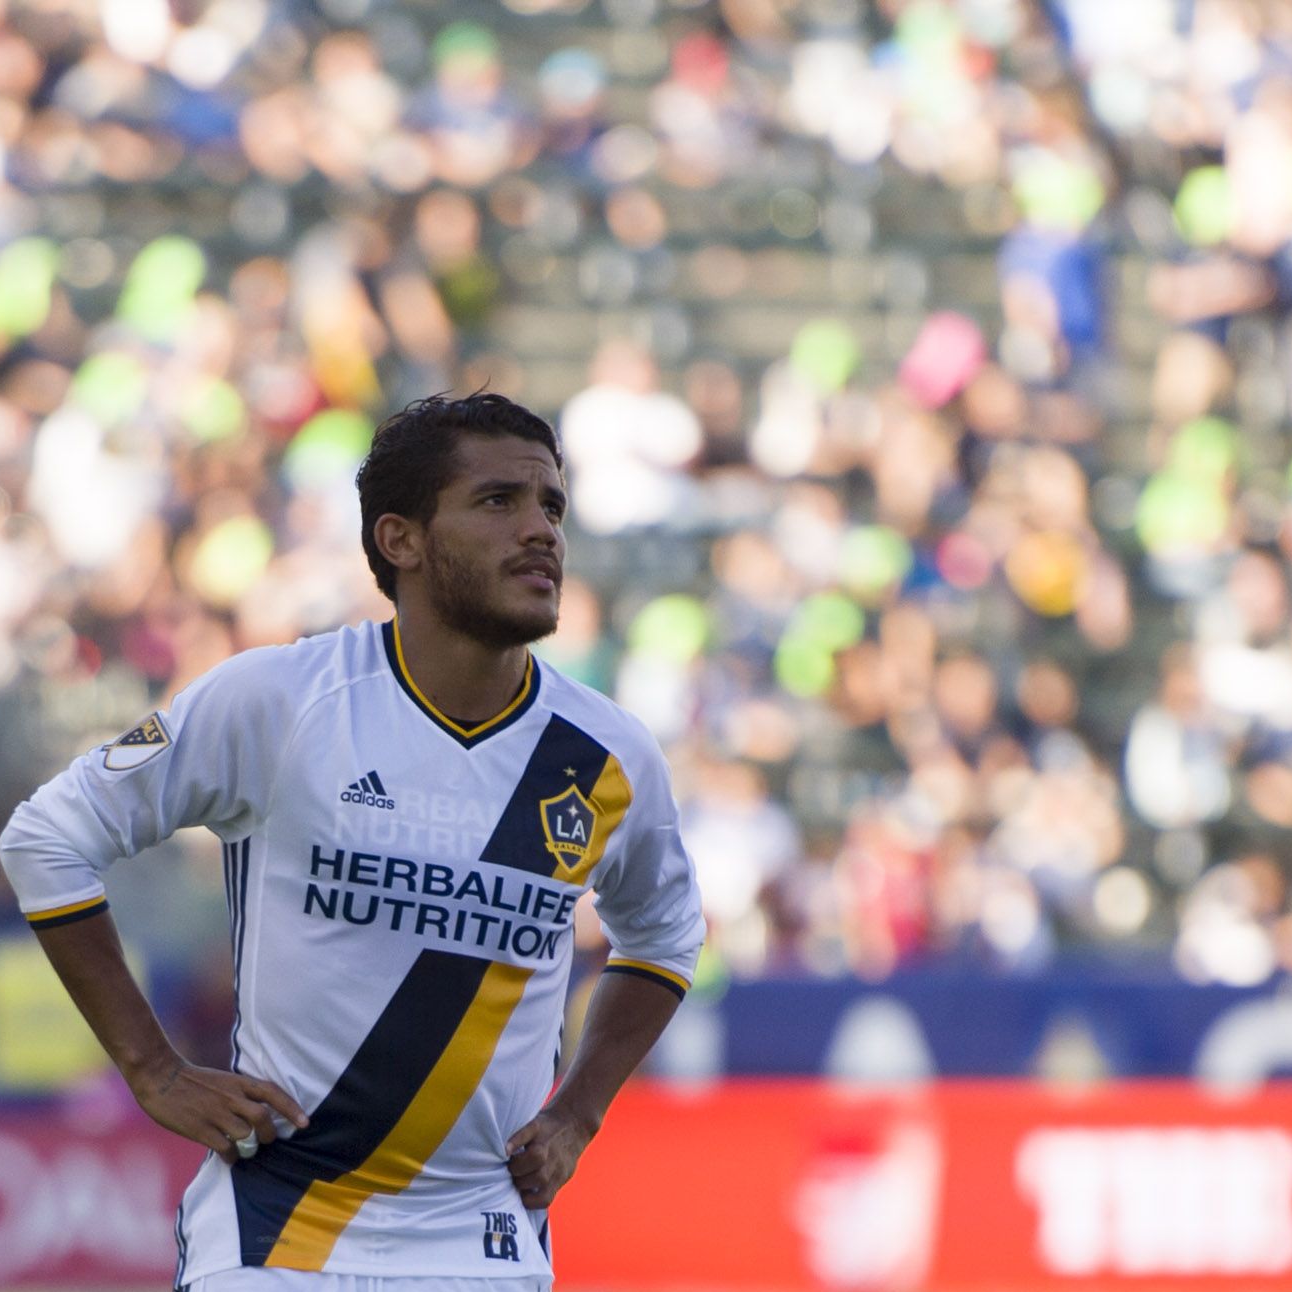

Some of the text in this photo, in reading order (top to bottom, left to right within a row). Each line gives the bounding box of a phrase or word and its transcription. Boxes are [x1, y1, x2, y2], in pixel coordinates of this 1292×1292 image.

[340, 790, 395, 811] adidas
[556, 814, 587, 842] LA
[310, 844, 580, 925] HERBALIFE
[303, 883, 558, 960] NUTRITION
[480, 1211, 517, 1235] THIS
[483, 1231, 520, 1262] LA
